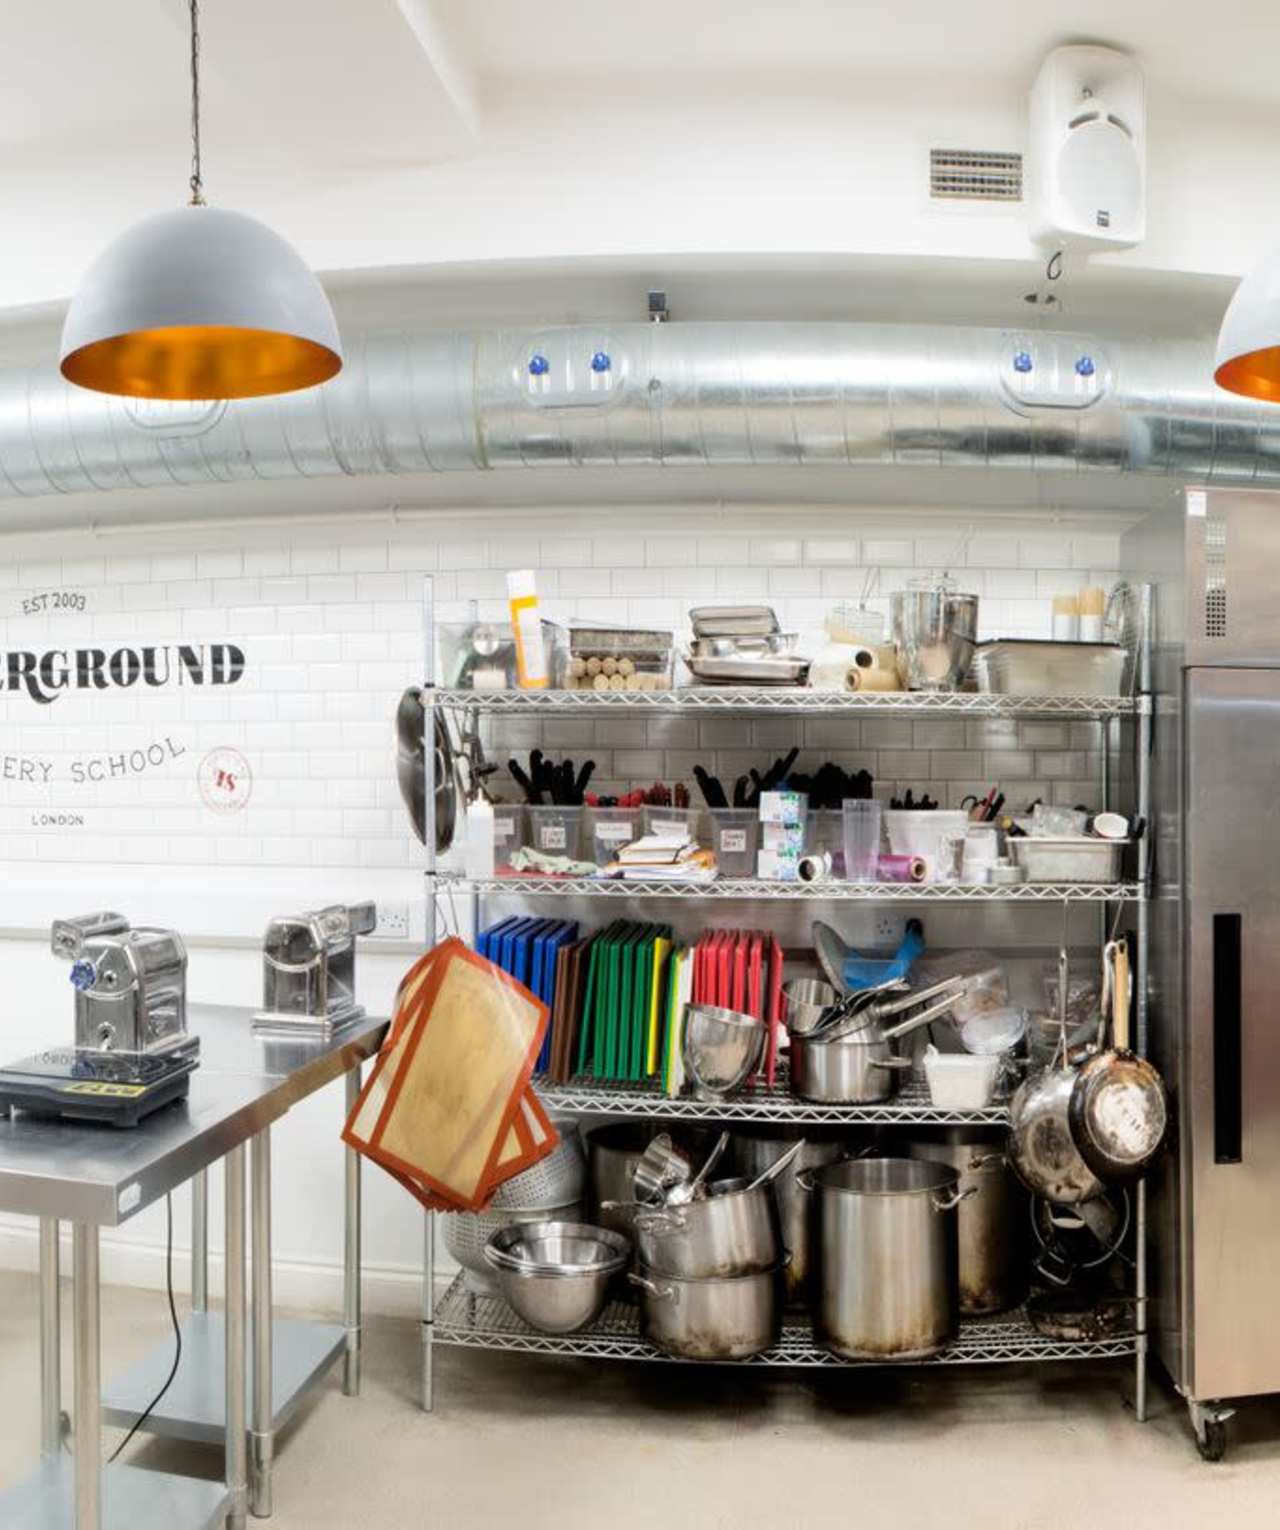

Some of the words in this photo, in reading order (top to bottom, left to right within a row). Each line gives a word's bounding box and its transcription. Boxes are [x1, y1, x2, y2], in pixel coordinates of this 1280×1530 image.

[22, 594, 48, 614] EST
[53, 591, 87, 612] 2003
[70, 737, 186, 783] SCHOOL
[31, 813, 84, 827] LONDON
